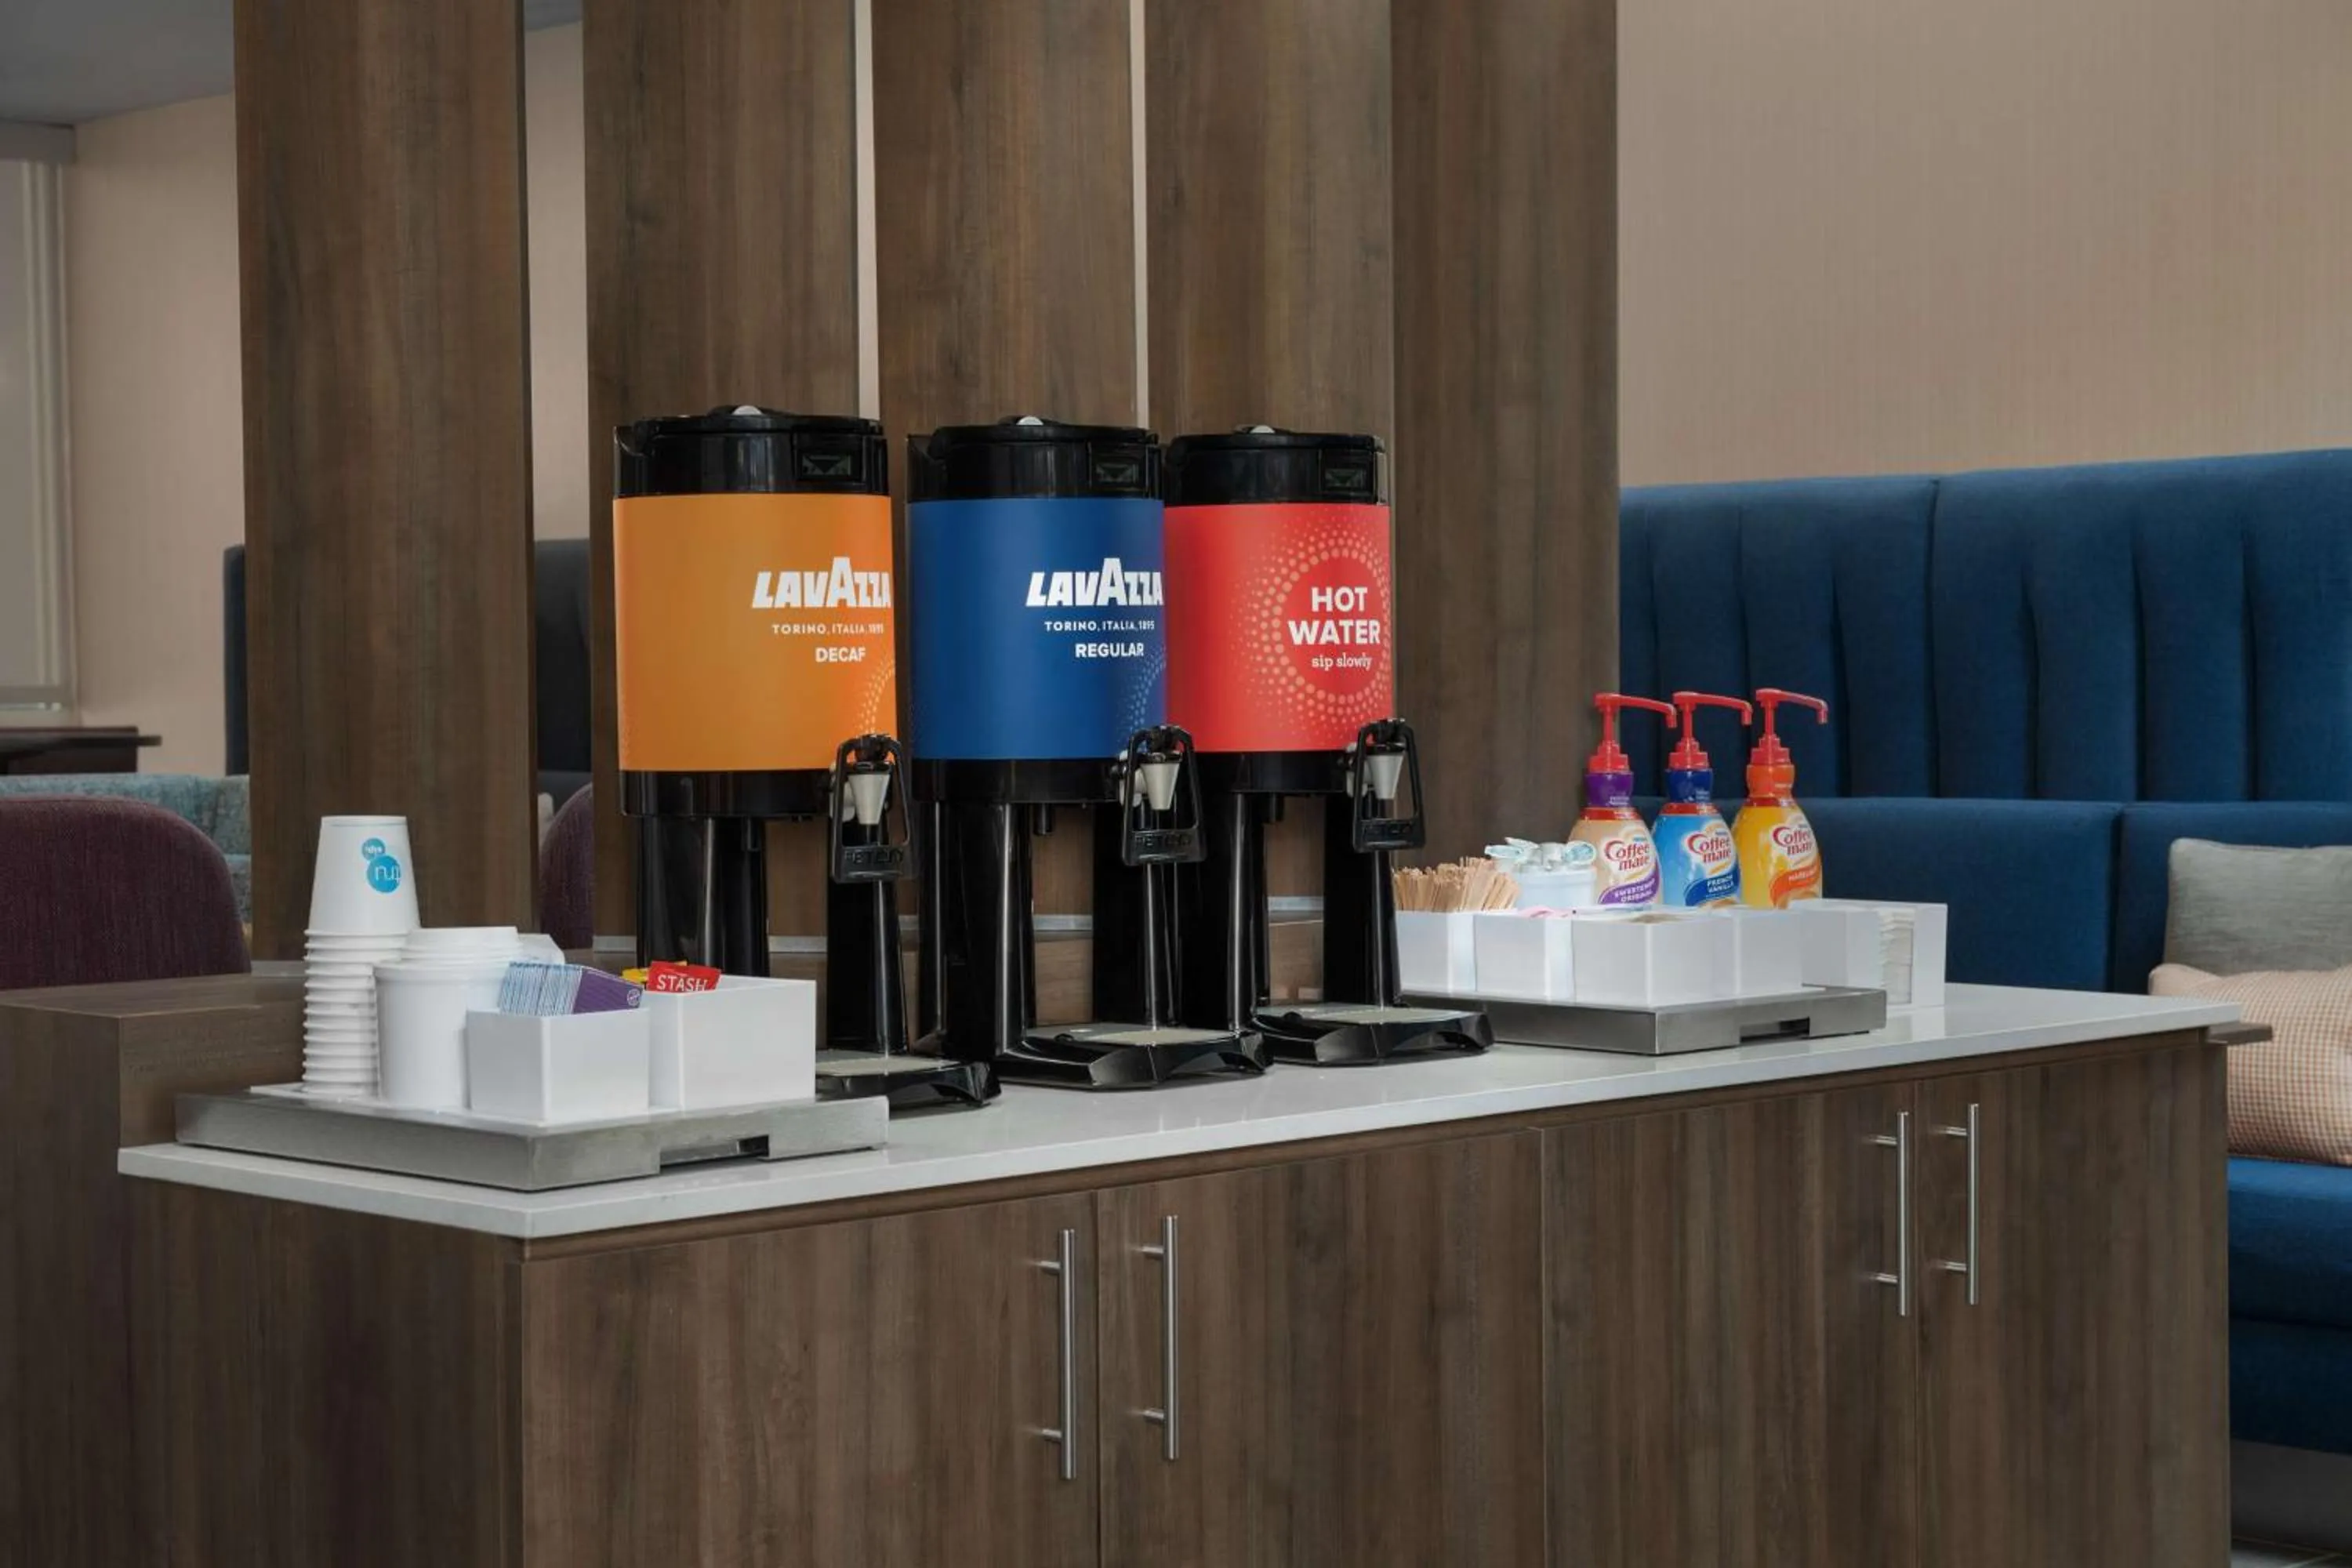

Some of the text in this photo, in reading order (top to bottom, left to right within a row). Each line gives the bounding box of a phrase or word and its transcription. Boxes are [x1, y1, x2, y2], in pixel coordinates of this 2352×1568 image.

[751, 556, 891, 608] LAVAZZA
[1025, 557, 1164, 606] LAVAZZA
[1310, 586, 1368, 612] HOT
[1287, 619, 1381, 645] WATER
[815, 646, 866, 662] DECAF
[1075, 642, 1145, 658] REGULAR
[1311, 652, 1372, 670] sip slowly
[1605, 840, 1650, 861] Coffee
[656, 974, 710, 992] STASH
